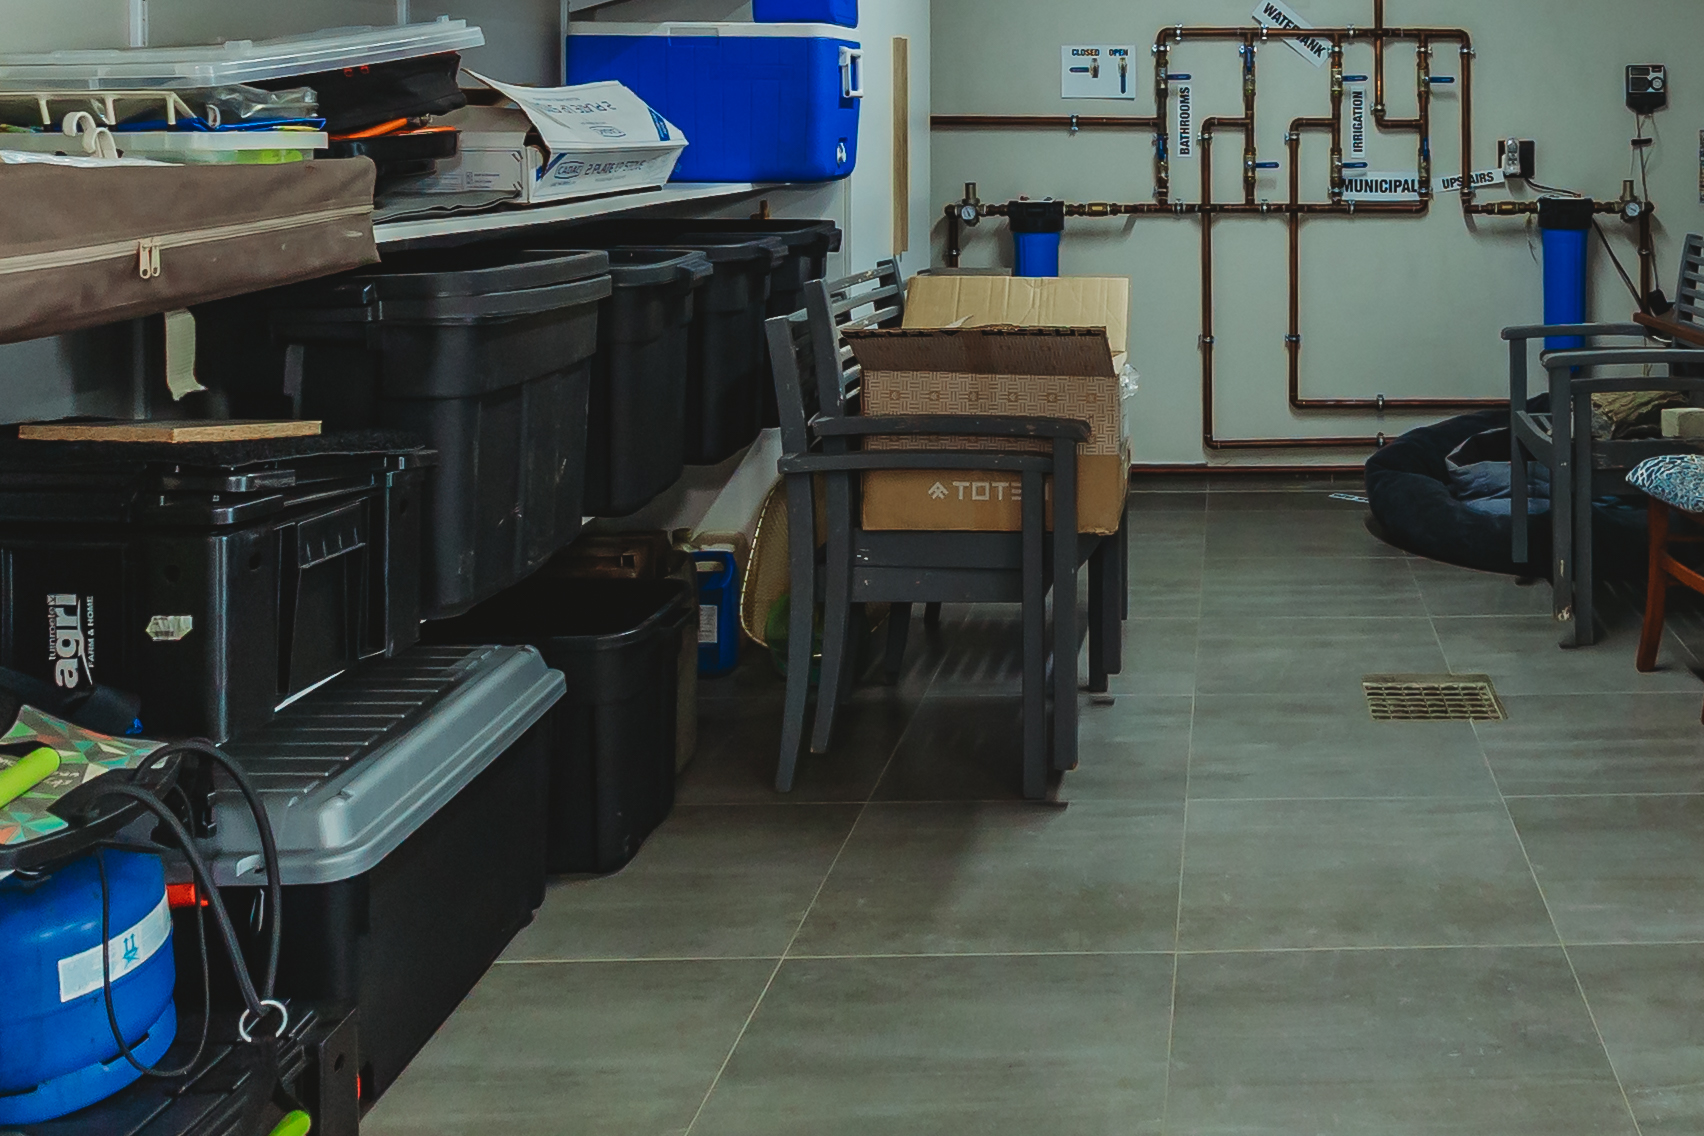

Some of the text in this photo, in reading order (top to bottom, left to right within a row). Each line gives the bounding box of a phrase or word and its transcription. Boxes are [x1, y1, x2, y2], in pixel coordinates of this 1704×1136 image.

[1071, 48, 1129, 57] CLOSED OPEN
[1296, 34, 1326, 59] ANK
[1179, 86, 1191, 155] BATHROOMS
[1352, 90, 1363, 153] IRRIGATION
[1342, 178, 1418, 194] MUNICIPAL
[1440, 171, 1495, 190] UPSAIRS
[86, 595, 94, 627] HOME
[55, 593, 85, 689] agri
